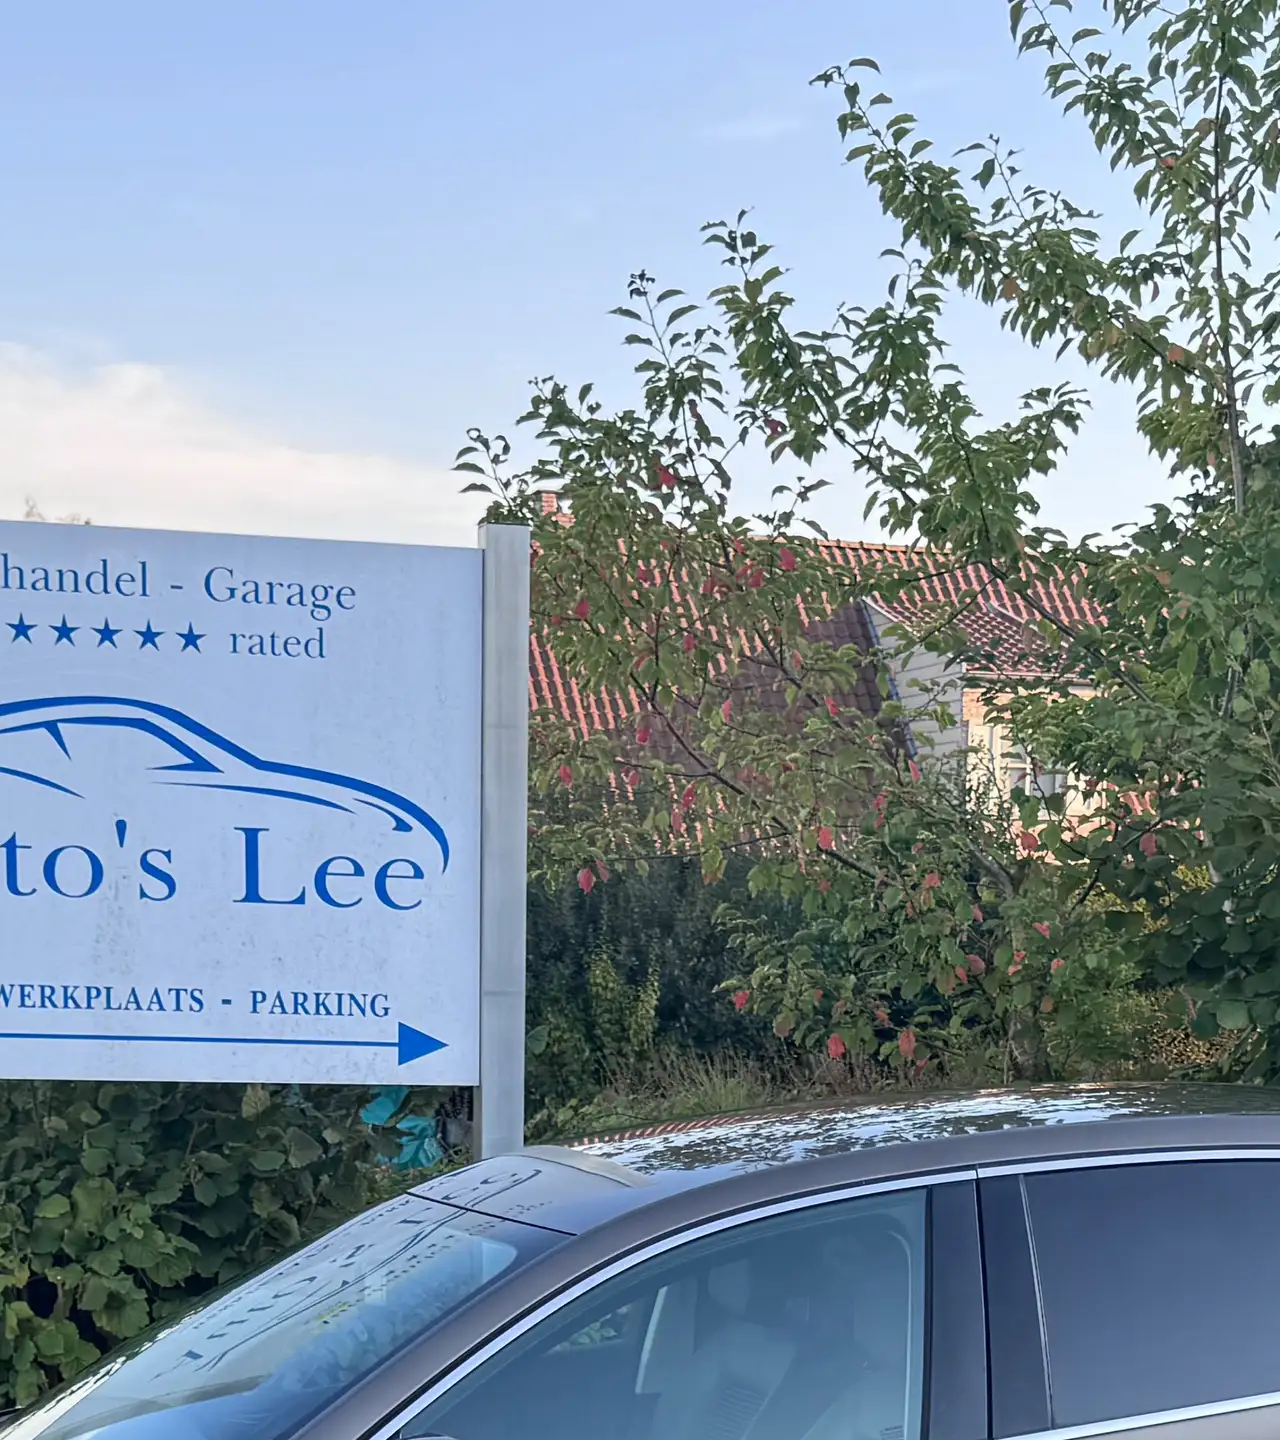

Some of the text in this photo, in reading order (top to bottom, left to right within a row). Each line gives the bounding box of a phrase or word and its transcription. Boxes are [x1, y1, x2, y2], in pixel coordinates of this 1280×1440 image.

[204, 567, 357, 622] Garage
[230, 627, 326, 659] rated
[233, 826, 425, 911] Lee
[249, 990, 391, 1018] PARKING
